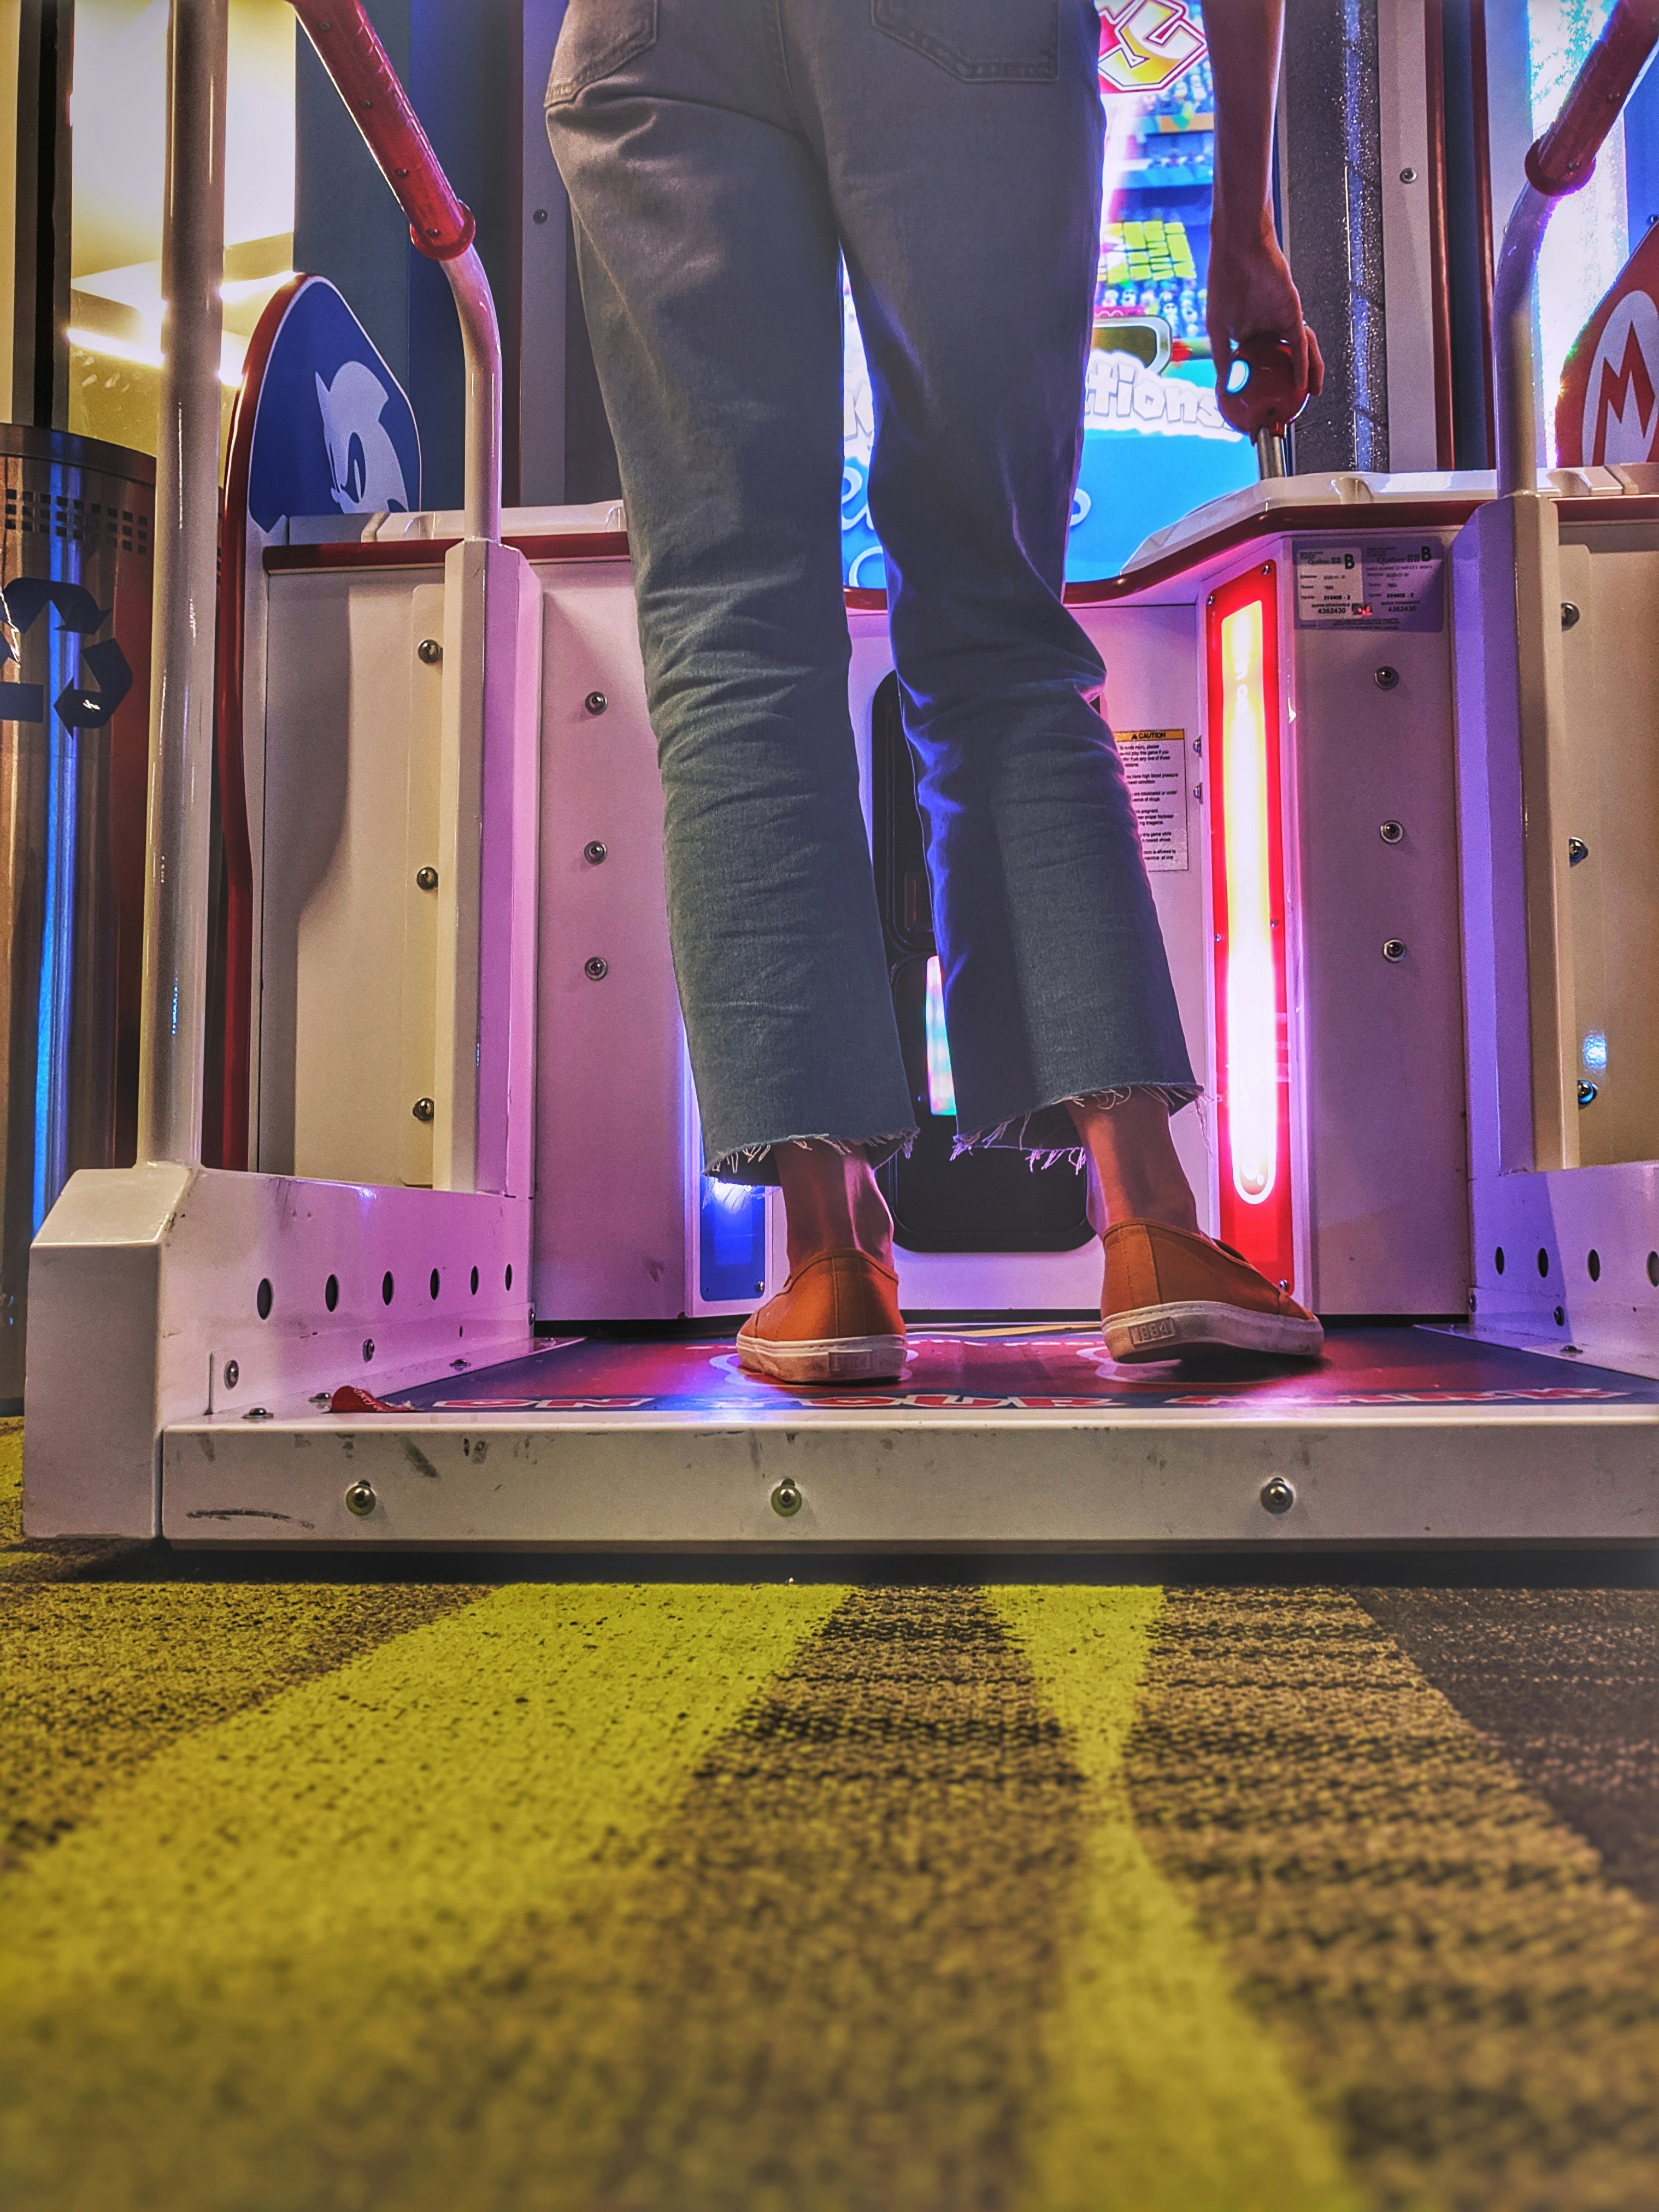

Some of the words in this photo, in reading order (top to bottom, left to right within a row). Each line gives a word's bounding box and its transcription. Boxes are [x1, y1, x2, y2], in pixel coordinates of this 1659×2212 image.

[1345, 554, 1355, 569] B
[1421, 546, 1432, 562] B
[433, 1397, 655, 1408] ON
